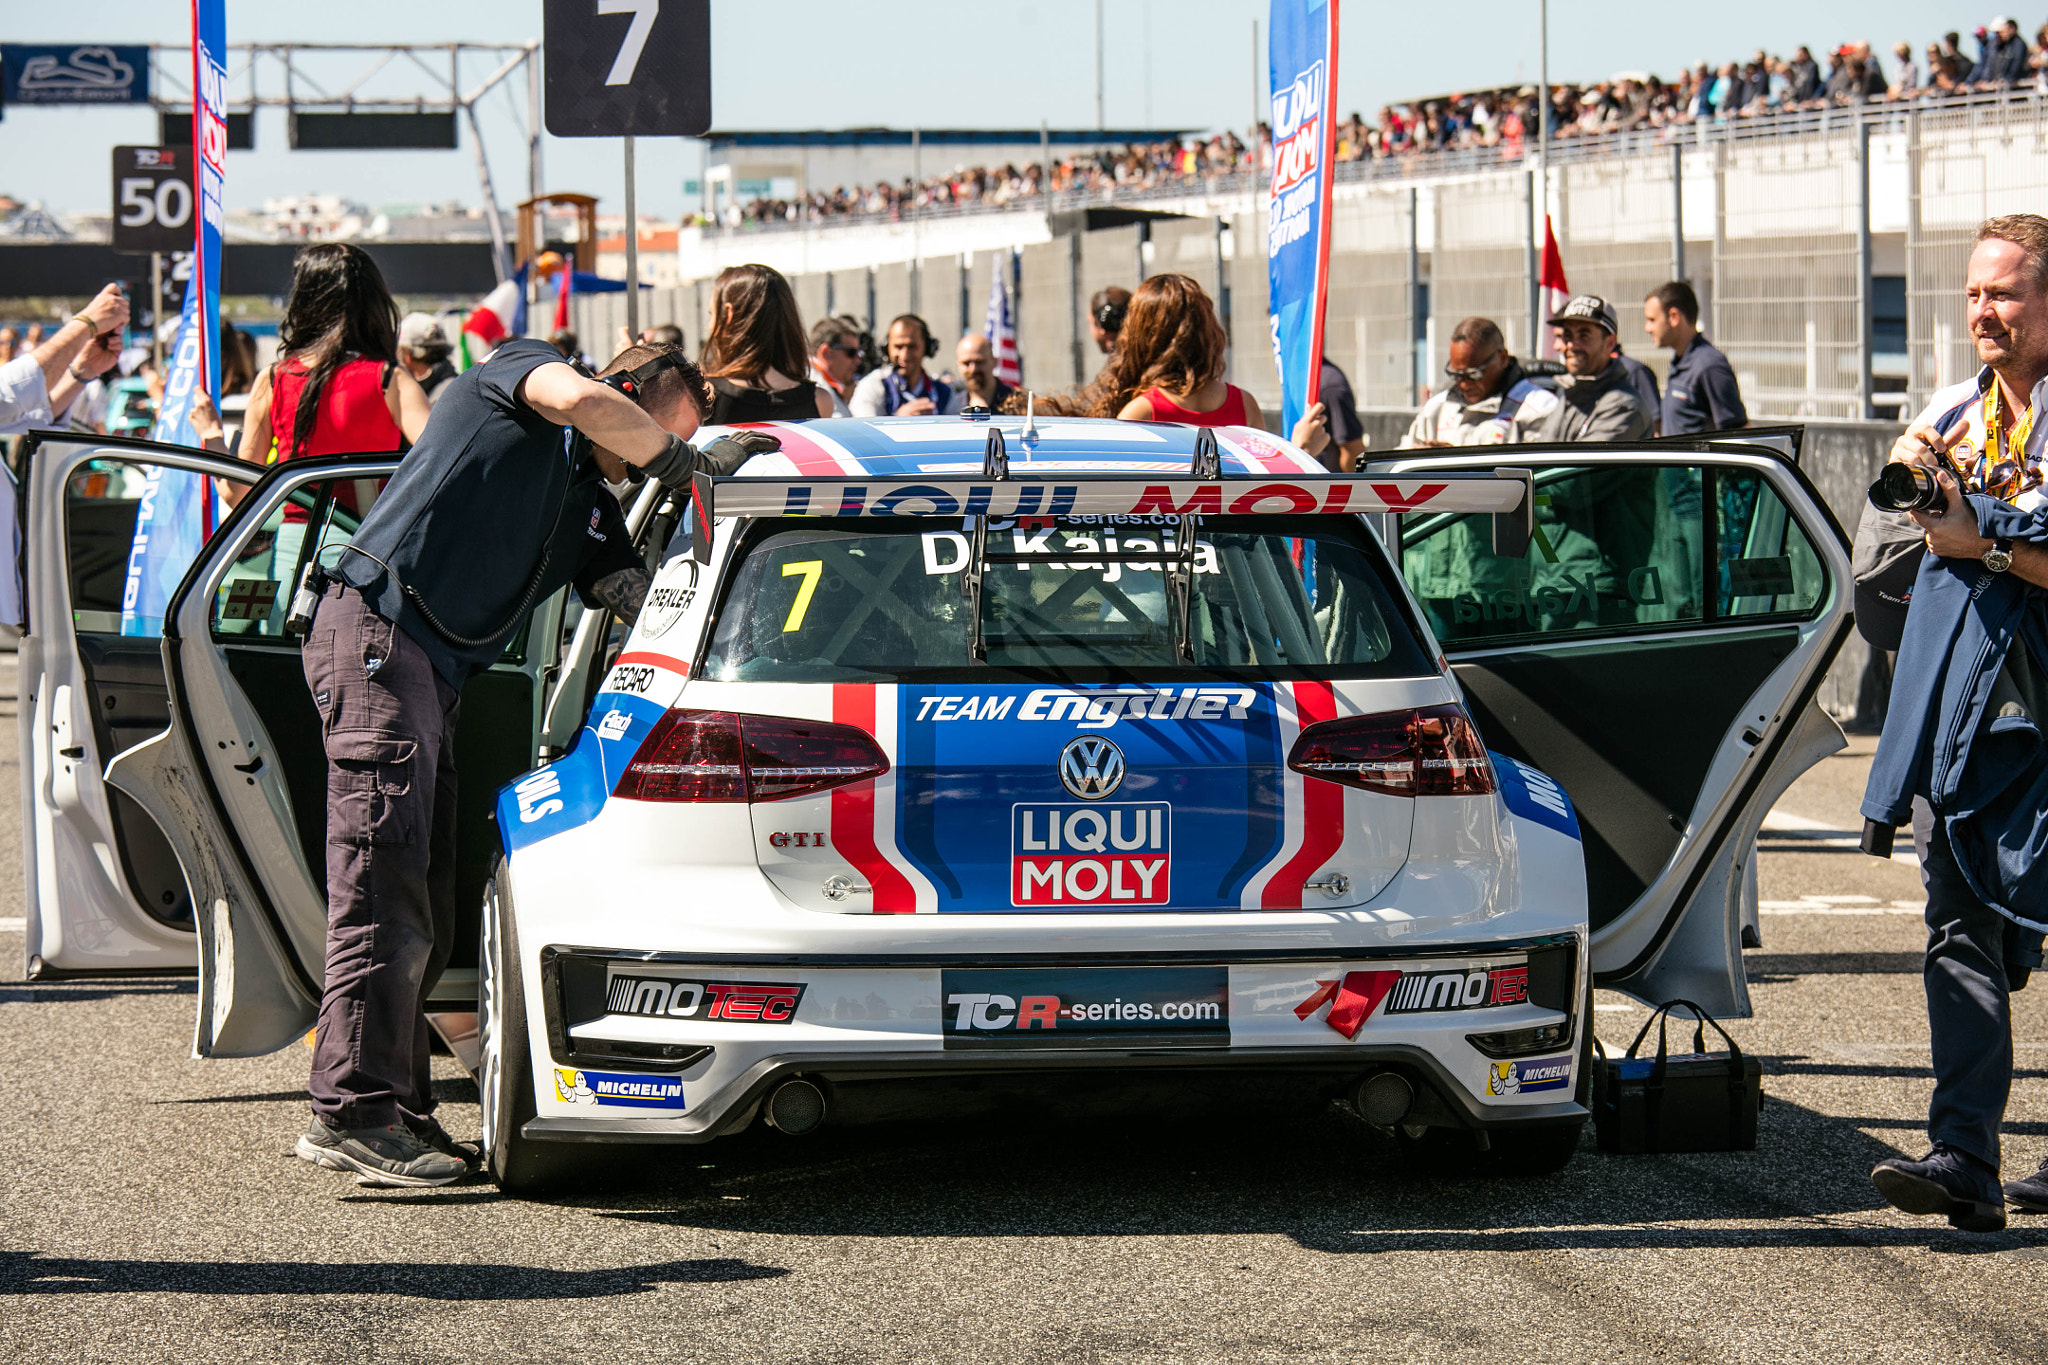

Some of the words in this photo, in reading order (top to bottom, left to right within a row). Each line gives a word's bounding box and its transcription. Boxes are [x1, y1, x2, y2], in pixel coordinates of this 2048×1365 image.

[597, 0, 659, 86] 7
[120, 177, 193, 228] 50
[1128, 484, 1449, 514] MOLY
[647, 588, 697, 613] DREXLER
[782, 560, 823, 633] 7
[609, 666, 655, 693] RECARO
[916, 696, 1016, 721] TEAM
[769, 831, 825, 847] GTI
[1021, 809, 1163, 853] LIQUI
[1021, 858, 1166, 901] MOLY
[947, 993, 1220, 1030] TCR-series.com
[1522, 1063, 1572, 1081] MICHELIN
[597, 1081, 682, 1097] MICHELIN
